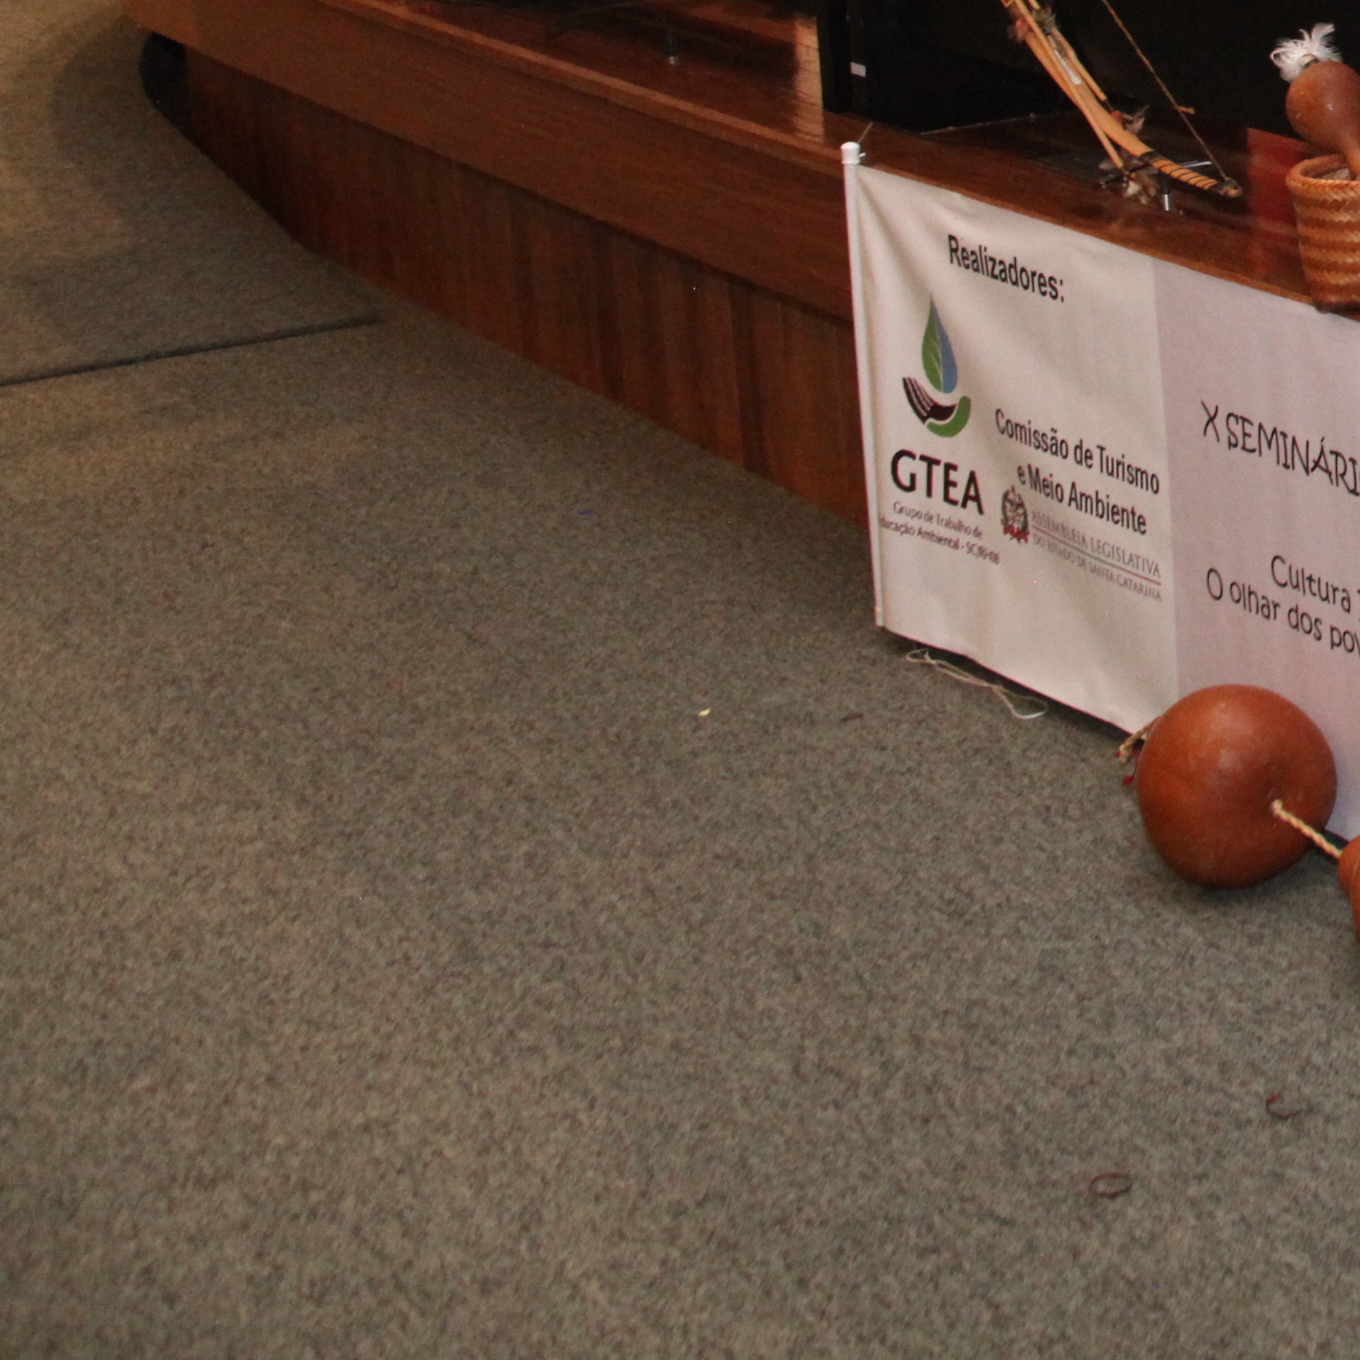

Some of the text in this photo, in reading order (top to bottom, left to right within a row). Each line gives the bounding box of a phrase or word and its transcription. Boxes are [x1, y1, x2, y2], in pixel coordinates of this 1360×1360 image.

[948, 234, 1065, 303] Realizadores:
[994, 408, 1160, 495] Comissão de Turismo
[1201, 400, 1220, 440] X
[890, 448, 984, 516] GTEA
[1017, 464, 1147, 535] e Meio Ambiente
[878, 516, 915, 536] ducação
[1090, 536, 1161, 579] LEGISLATIVA
[1116, 573, 1162, 602] CATARINA
[1206, 568, 1224, 601] O
[1228, 578, 1281, 624] olhar
[1287, 605, 1323, 643] dos
[1270, 553, 1353, 614] Cultura
